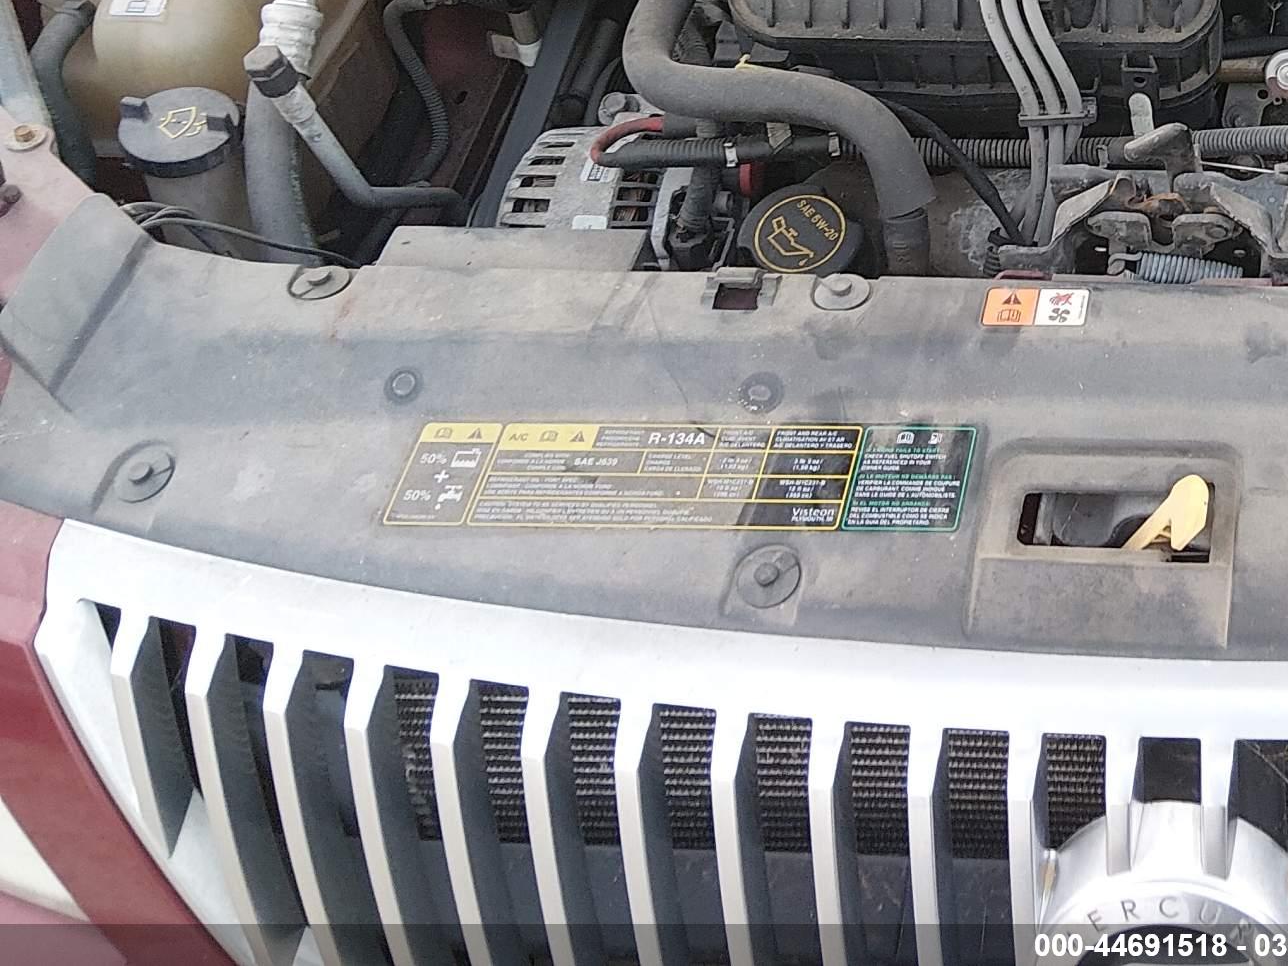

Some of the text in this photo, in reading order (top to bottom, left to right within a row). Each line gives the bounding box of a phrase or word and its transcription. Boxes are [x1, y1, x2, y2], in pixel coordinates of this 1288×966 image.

[796, 199, 816, 218] SAE
[508, 433, 529, 442] A/C
[647, 431, 706, 446] R-134A
[419, 452, 448, 465] 50%
[574, 457, 594, 466] SAE
[402, 489, 432, 501] 50%
[791, 507, 835, 518] Visteon
